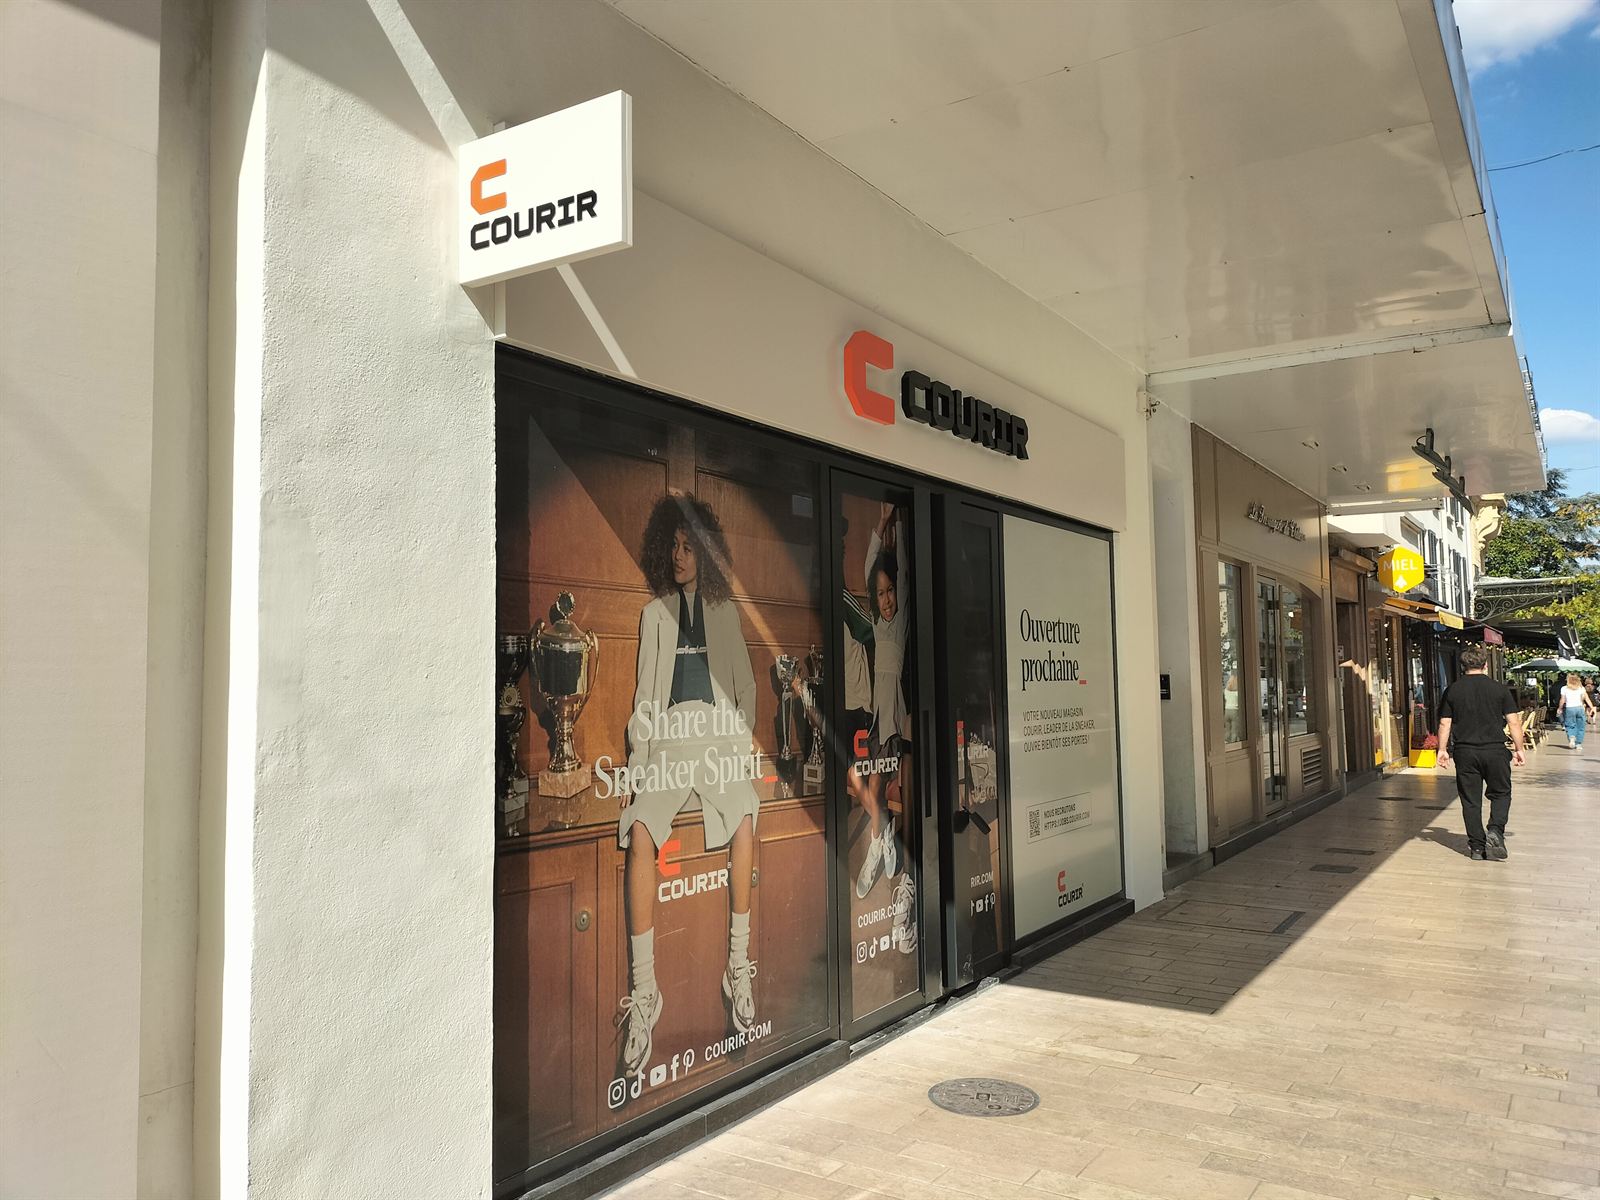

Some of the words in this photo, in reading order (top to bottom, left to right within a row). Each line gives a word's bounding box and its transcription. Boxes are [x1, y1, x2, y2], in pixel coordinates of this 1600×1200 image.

[470, 189, 598, 251] COURIR
[901, 370, 1029, 460] COURIR
[1383, 558, 1418, 571] MIEL
[1020, 608, 1081, 644] Ouverture
[636, 699, 707, 742] Share
[712, 698, 747, 736] the
[1022, 710, 1040, 721] VOTRE
[1040, 708, 1063, 720] NOUVEAU
[1063, 707, 1084, 718] MAGASIN
[1043, 722, 1062, 735] LEADER
[1062, 721, 1069, 732] DE
[1023, 740, 1041, 753] OUVRE
[1062, 736, 1071, 748] SES
[594, 750, 700, 800] Sneaker
[854, 756, 899, 777] COURIR
[658, 868, 729, 903] COURIR
[1057, 886, 1084, 908] COURIR
[704, 1020, 773, 1062] COURIR.COM
